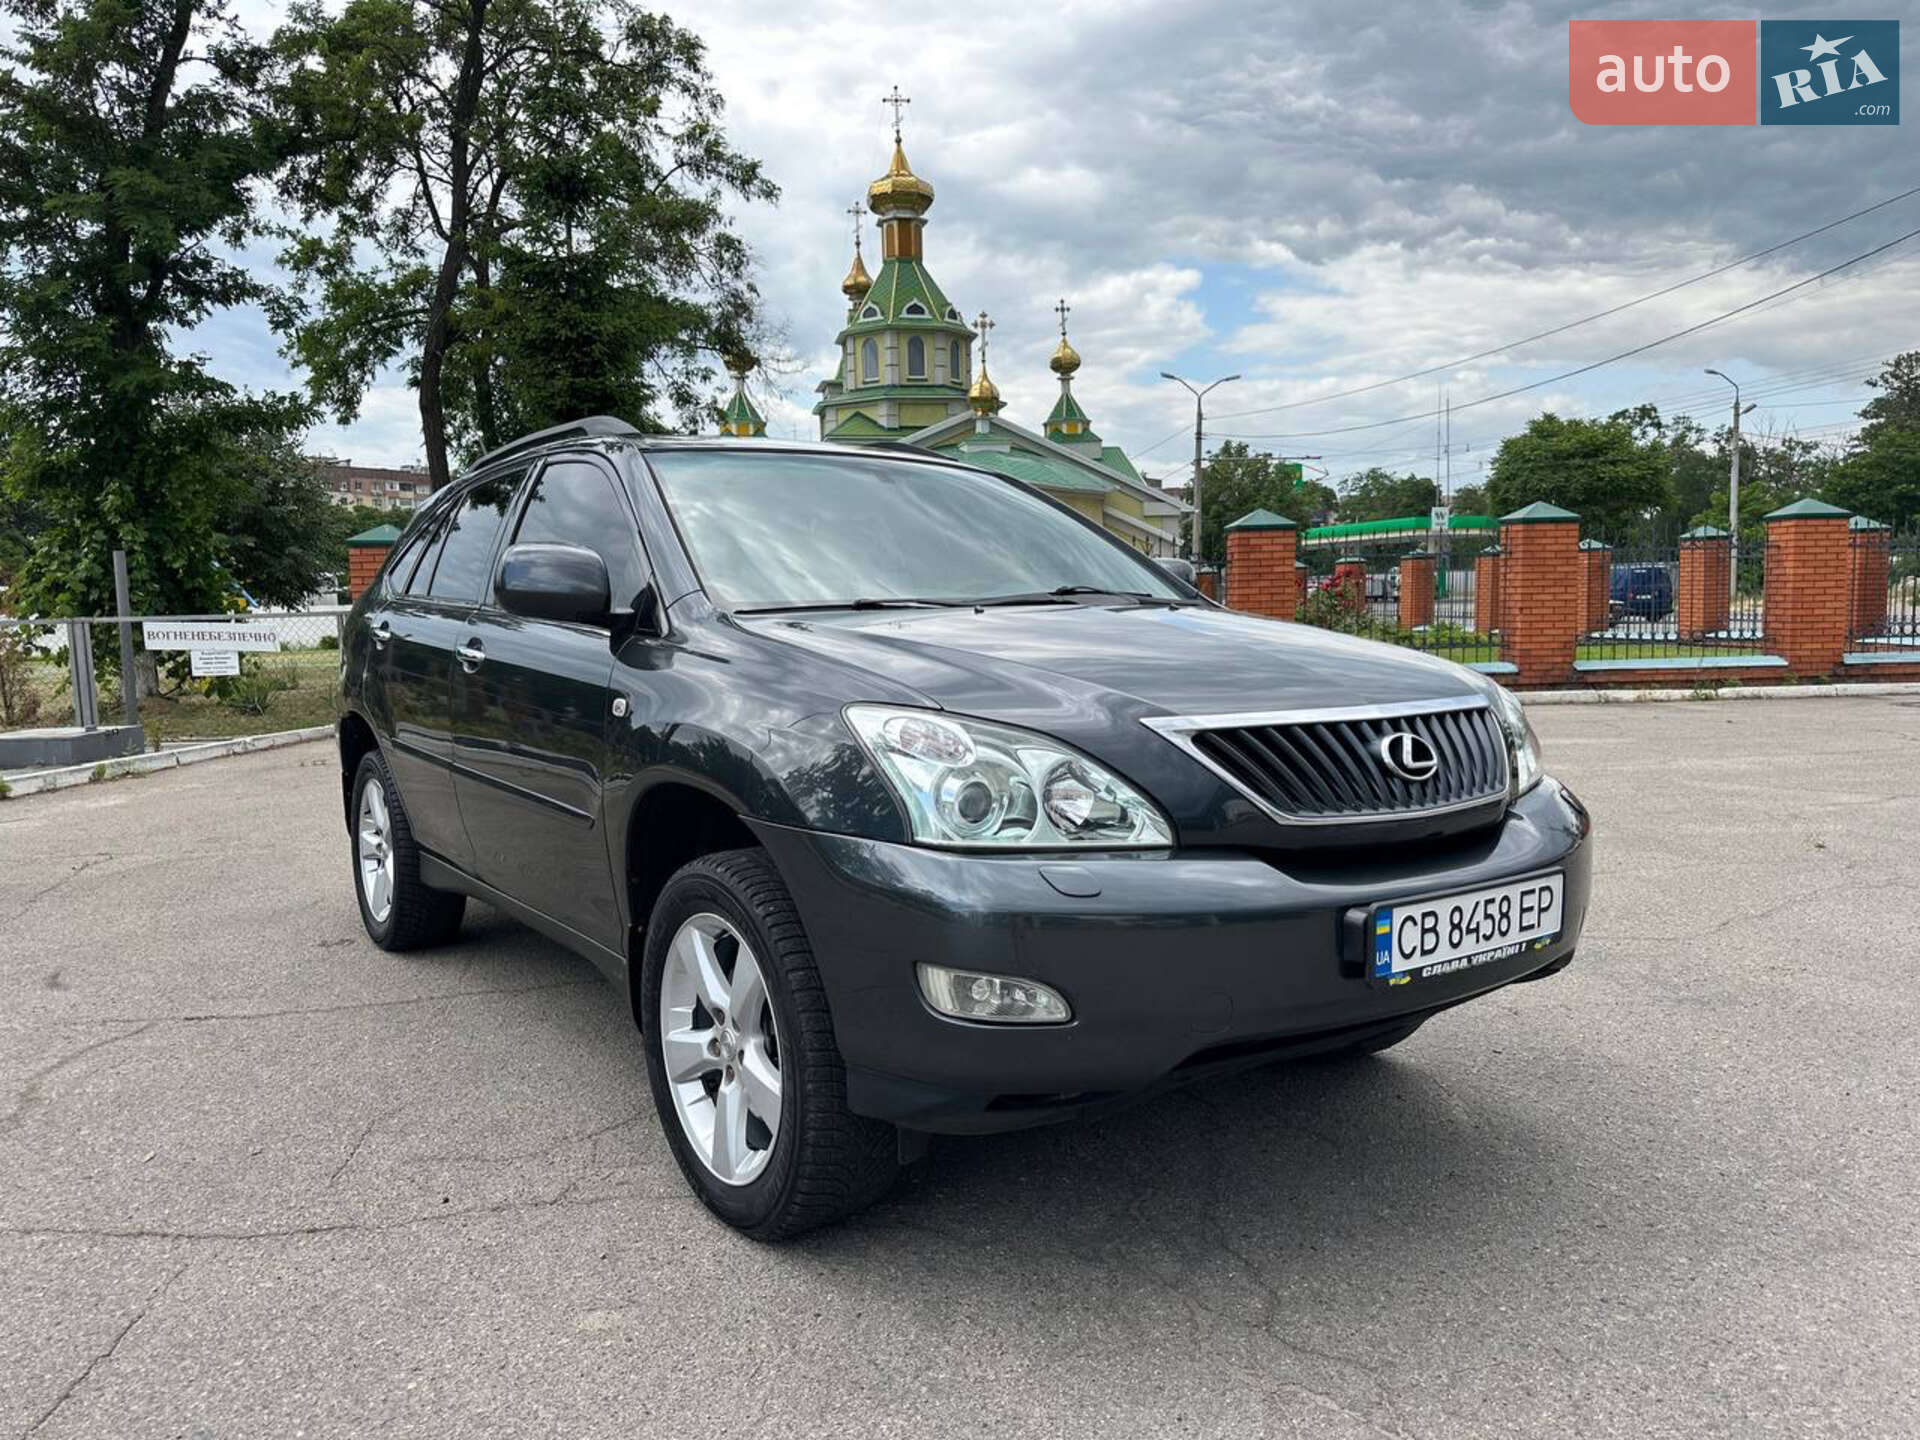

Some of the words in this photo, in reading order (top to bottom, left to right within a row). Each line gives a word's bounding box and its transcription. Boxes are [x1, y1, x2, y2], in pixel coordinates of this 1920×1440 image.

[147, 630, 277, 643] ВОГНЕНЕБЕЗПЕЧНО
[1448, 895, 1511, 949] 8458
[1376, 950, 1390, 966] UA
[1421, 957, 1469, 978] СЛАВА
